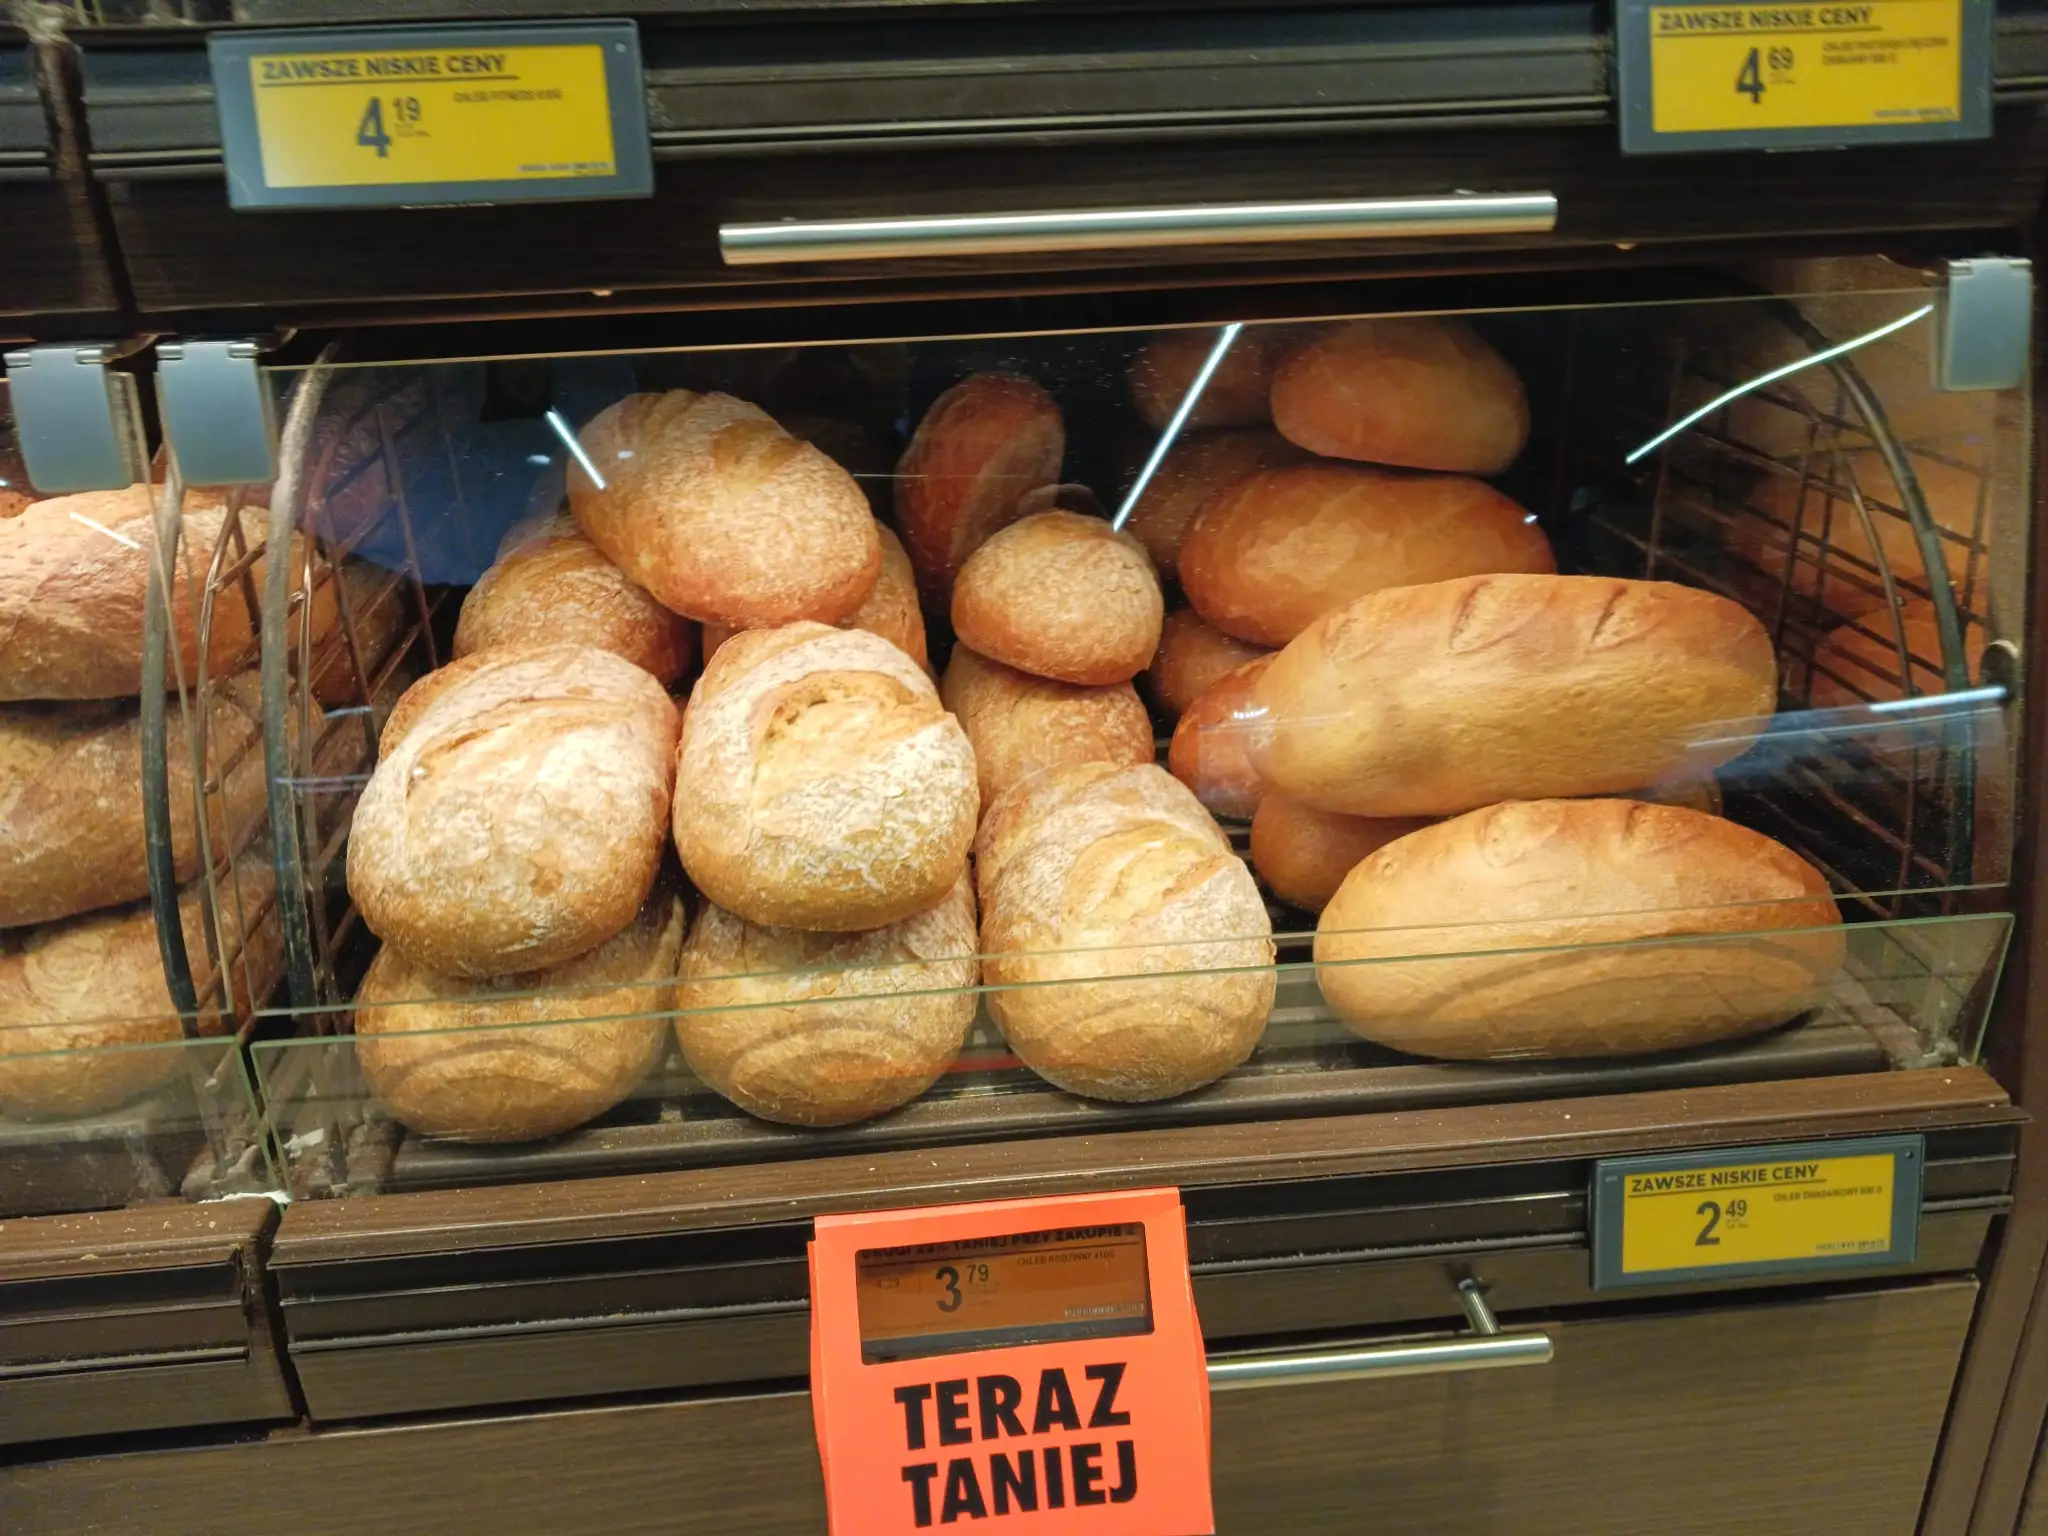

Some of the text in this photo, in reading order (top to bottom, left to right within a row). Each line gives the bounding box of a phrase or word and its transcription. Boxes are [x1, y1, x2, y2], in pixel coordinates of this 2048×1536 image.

[1658, 5, 1873, 31] ZAWSZE NISKIE CENY
[261, 53, 507, 80] ZAWSZE NISKIE CENY
[1735, 46, 1766, 104] 4
[356, 96, 421, 159] 4 19
[1631, 1164, 1819, 1193] ZAWSZE NISKIE CENY
[1055, 1226, 1122, 1242] ZAKUPIE
[1695, 1199, 1748, 1246] 2 49
[1016, 1255, 1046, 1267] CHLEB
[1048, 1252, 1092, 1264] RODZINNY
[935, 1264, 989, 1313] 3 79
[893, 1362, 1132, 1451] TERAZ
[900, 1440, 1139, 1529] TANIEJ
